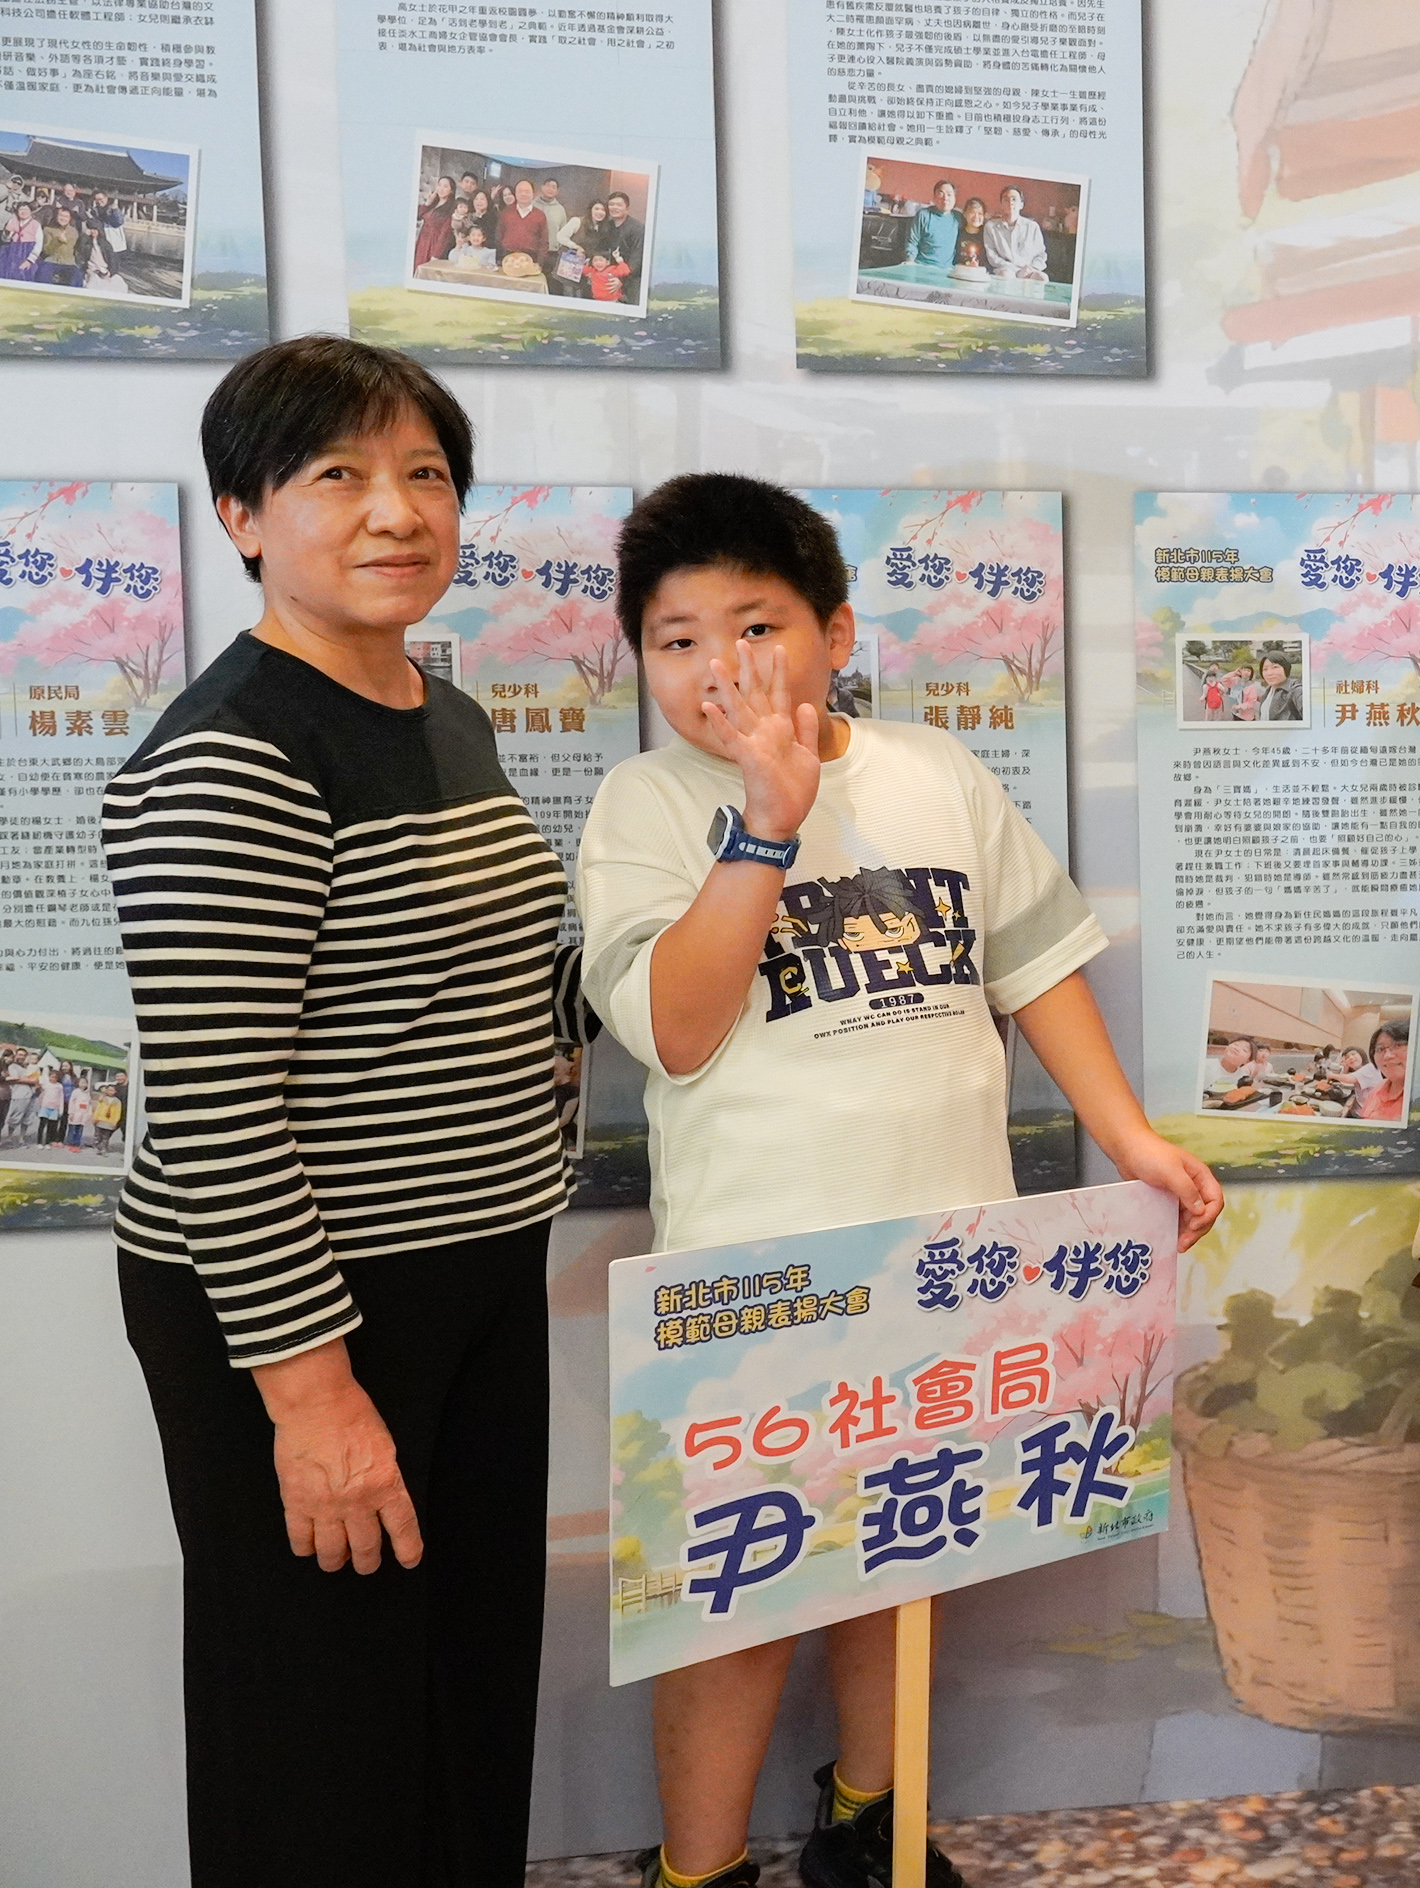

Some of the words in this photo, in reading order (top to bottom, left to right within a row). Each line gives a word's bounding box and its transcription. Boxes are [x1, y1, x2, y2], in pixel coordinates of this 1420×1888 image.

[1155, 548, 1239, 565] 新北市115年
[1155, 565, 1275, 584] 模範母親表揚大會
[29, 685, 80, 700] 原民局
[491, 683, 540, 698] 兒少科
[925, 682, 971, 697] 兒少科
[1335, 679, 1380, 695] 社婦科
[28, 709, 130, 737] 楊素雲
[923, 704, 1016, 731] 張靜純
[0, 756, 126, 767] 於台東大武鄉的大鳥部落
[880, 993, 914, 1008] 1987
[655, 1264, 811, 1317] 新北市115年
[655, 1285, 871, 1350] 模範母親表揚大會
[688, 1412, 1134, 1614] 尹燕秋
